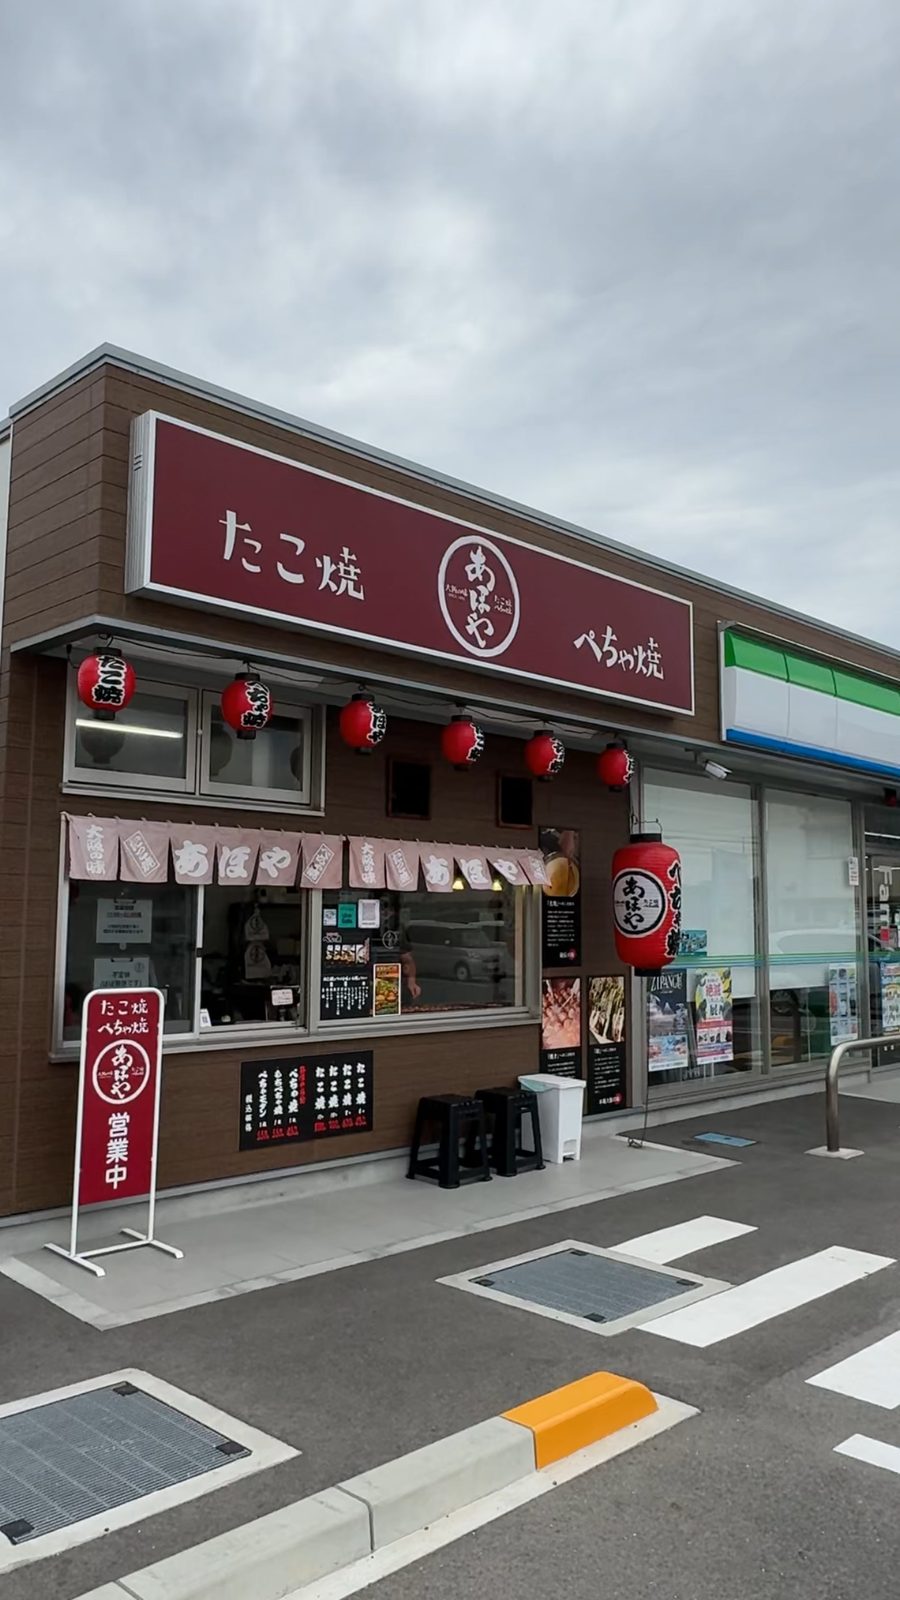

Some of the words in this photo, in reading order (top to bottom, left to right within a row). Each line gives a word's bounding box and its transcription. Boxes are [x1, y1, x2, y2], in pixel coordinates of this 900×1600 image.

[219, 509, 365, 601] たこ焼
[464, 545, 496, 648] あほや
[573, 625, 664, 680] ぺちゃ焼
[92, 655, 127, 706] たこ焼
[86, 824, 105, 875] 大阪の味
[174, 839, 291, 880] あほや
[361, 842, 376, 884] 大阪の味
[622, 876, 645, 930] あほや
[97, 1017, 150, 1036] ぺちゃ焼
[101, 998, 149, 1016] たこ焼
[110, 1044, 133, 1099] あほや
[314, 1066, 326, 1110] たこ焼
[328, 1065, 339, 1108] たこ焼
[342, 1064, 352, 1107] たこ焼
[356, 1062, 366, 1105] たこ焼
[105, 1111, 130, 1190] 営業中
